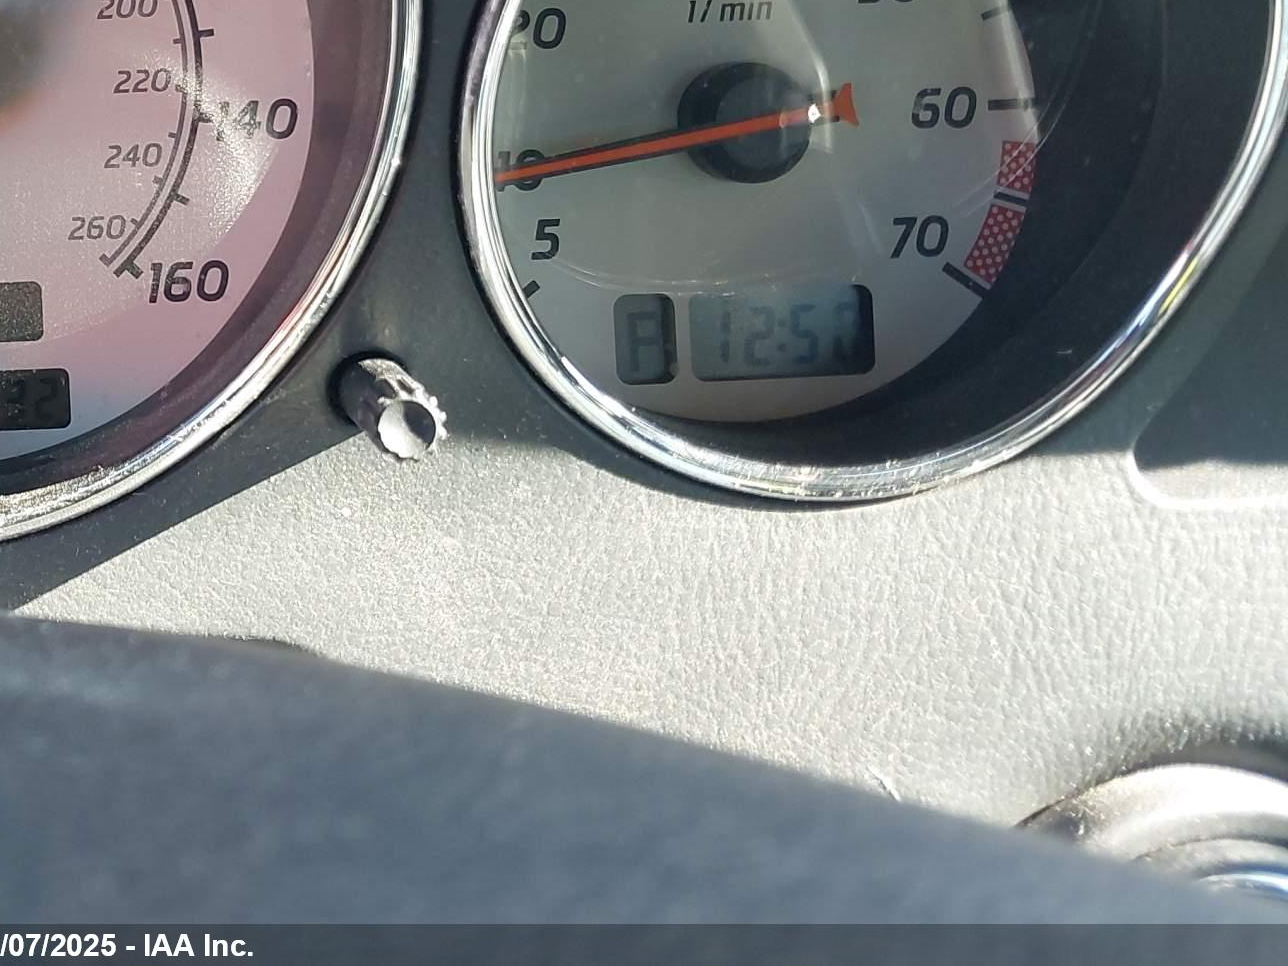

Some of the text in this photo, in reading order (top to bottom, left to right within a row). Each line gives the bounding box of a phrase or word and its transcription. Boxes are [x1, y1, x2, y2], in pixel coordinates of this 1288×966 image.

[113, 67, 172, 95] 220
[216, 98, 299, 142] 140
[910, 86, 978, 130] 60
[104, 142, 163, 169] 240
[68, 214, 126, 241] 260
[530, 218, 561, 261] 5
[890, 214, 950, 259] 70
[148, 259, 230, 304] 160
